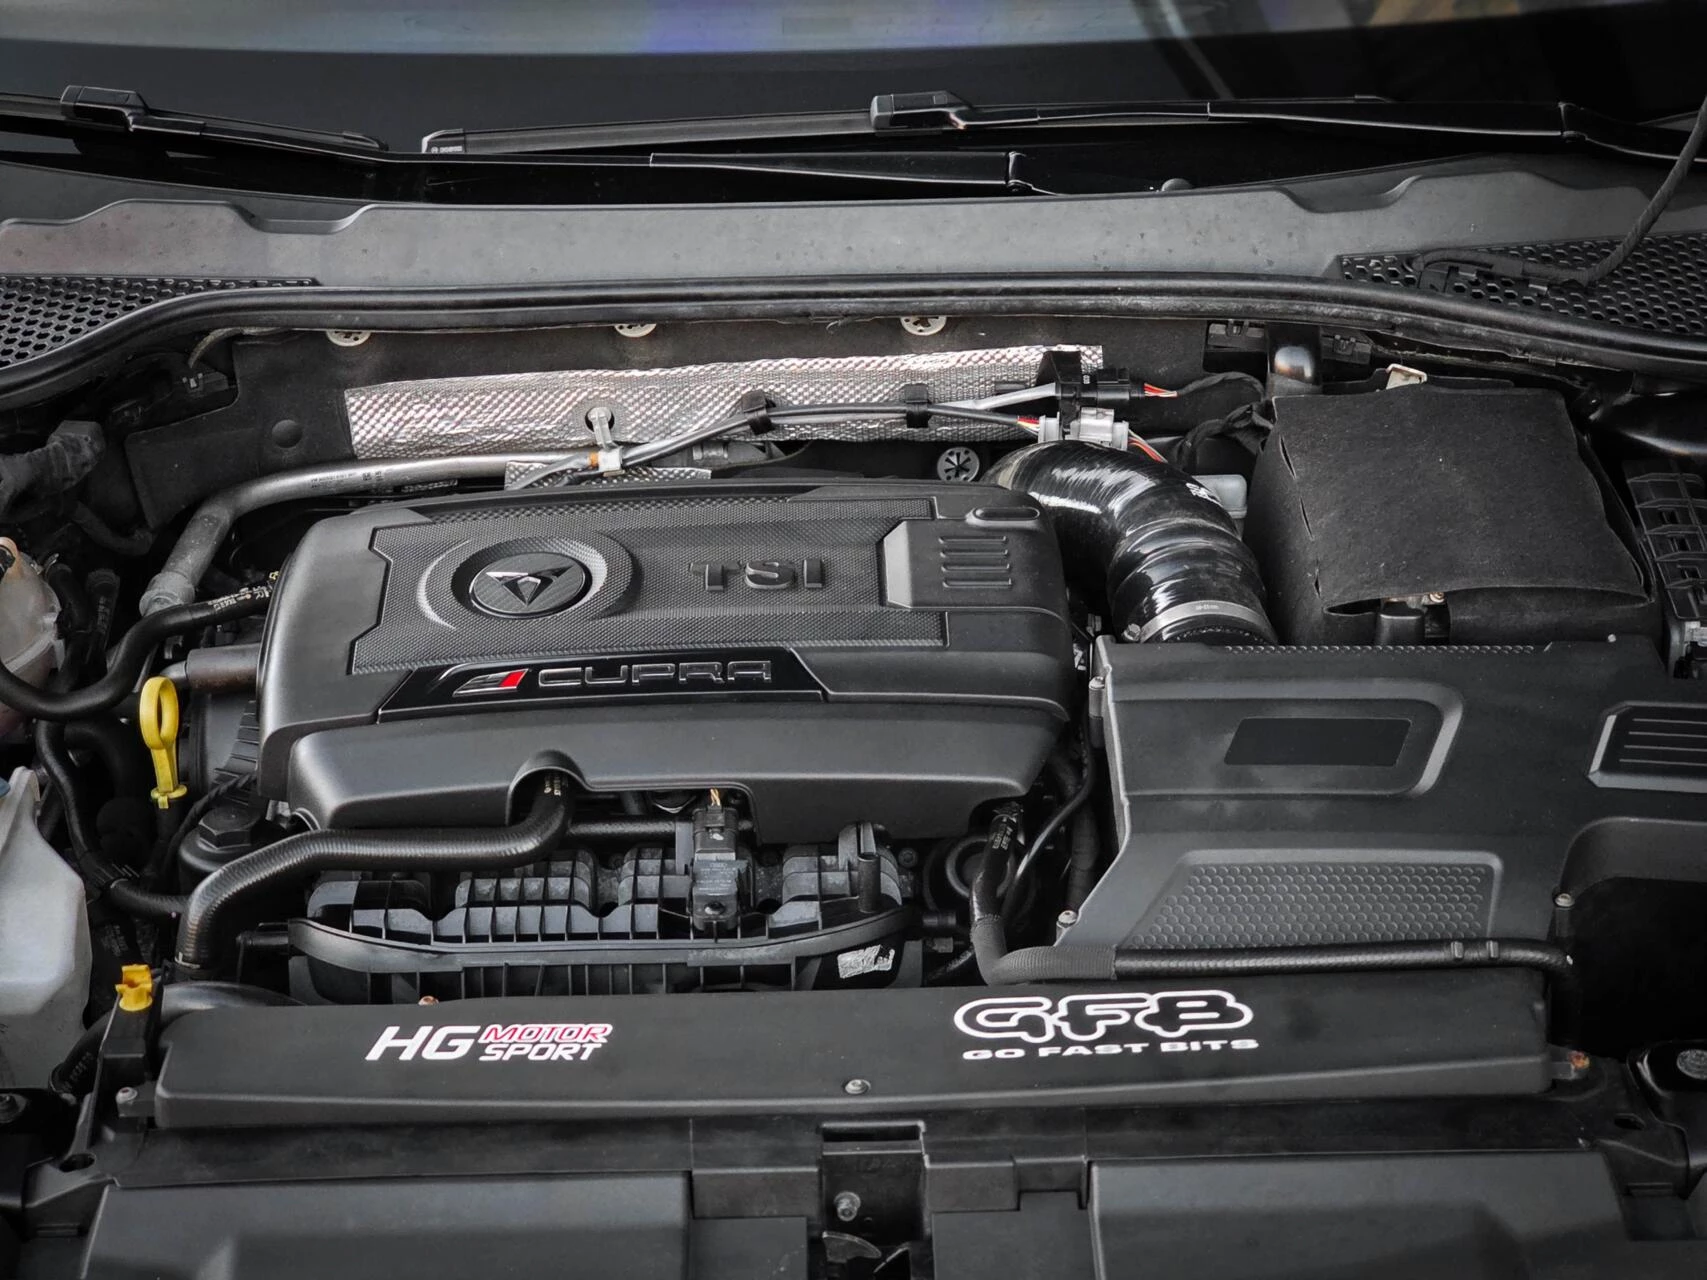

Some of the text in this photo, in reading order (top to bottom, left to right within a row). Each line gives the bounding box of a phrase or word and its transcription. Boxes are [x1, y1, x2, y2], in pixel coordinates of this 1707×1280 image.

[689, 559, 825, 591] TSI
[538, 661, 771, 688] CUPRA
[954, 989, 1254, 1043] GFB
[365, 1023, 613, 1061] HG MOTOR
[479, 1043, 602, 1061] SPORT
[962, 1039, 1259, 1060] GO FAST BITS
